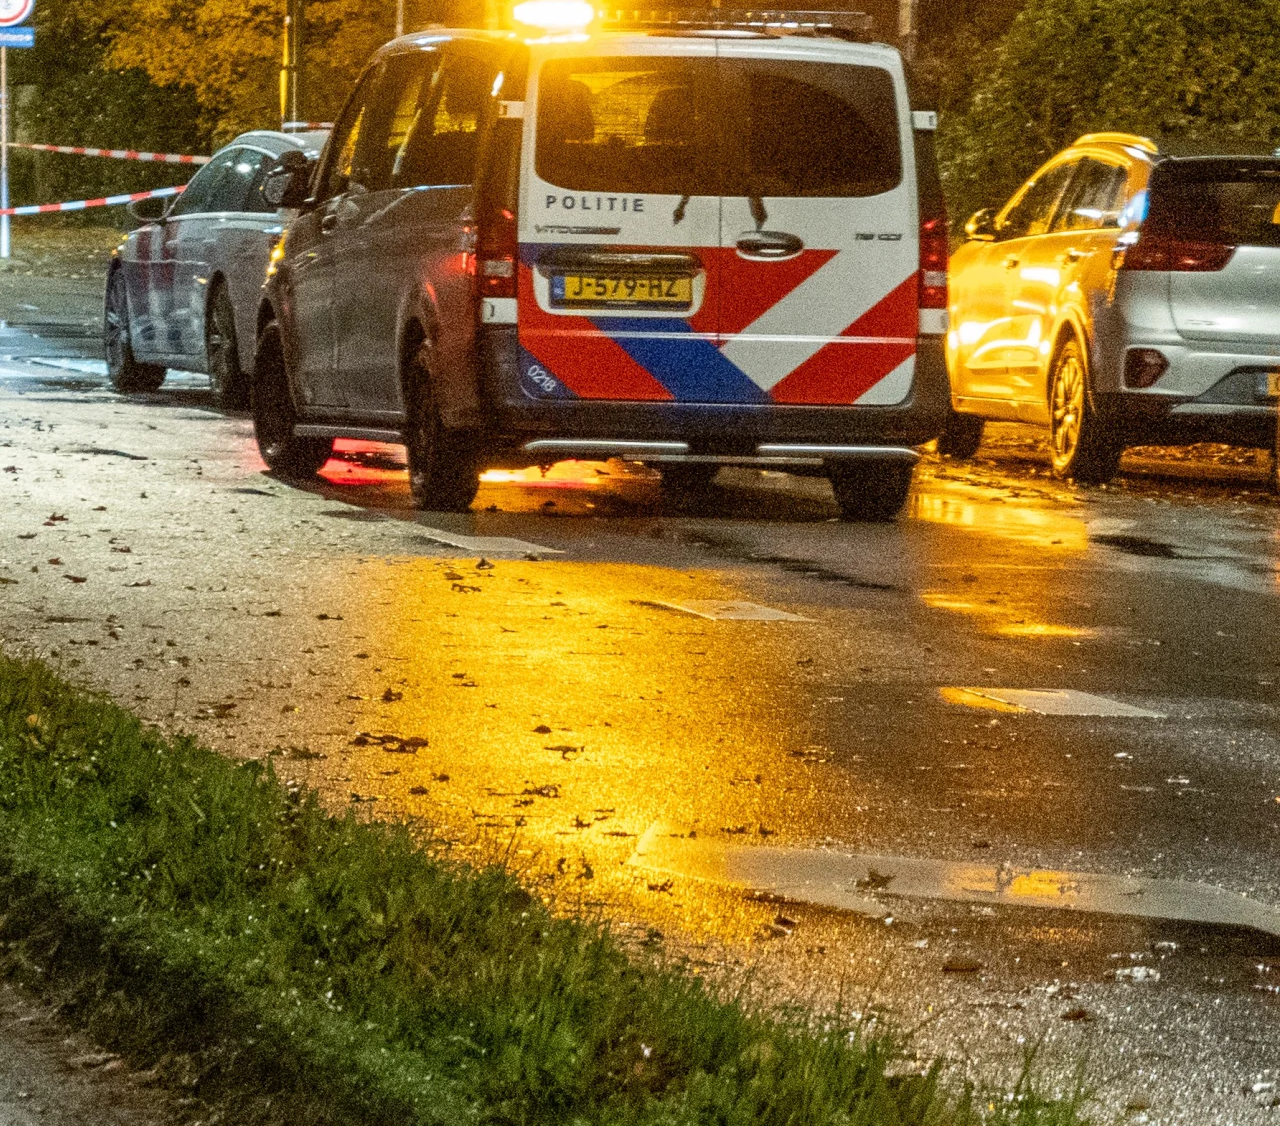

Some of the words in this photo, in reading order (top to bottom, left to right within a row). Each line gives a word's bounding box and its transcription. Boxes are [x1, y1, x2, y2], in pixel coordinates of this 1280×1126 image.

[545, 194, 645, 213] POLITIE
[572, 274, 679, 298] J-579-HZ
[527, 364, 557, 392] 0218
